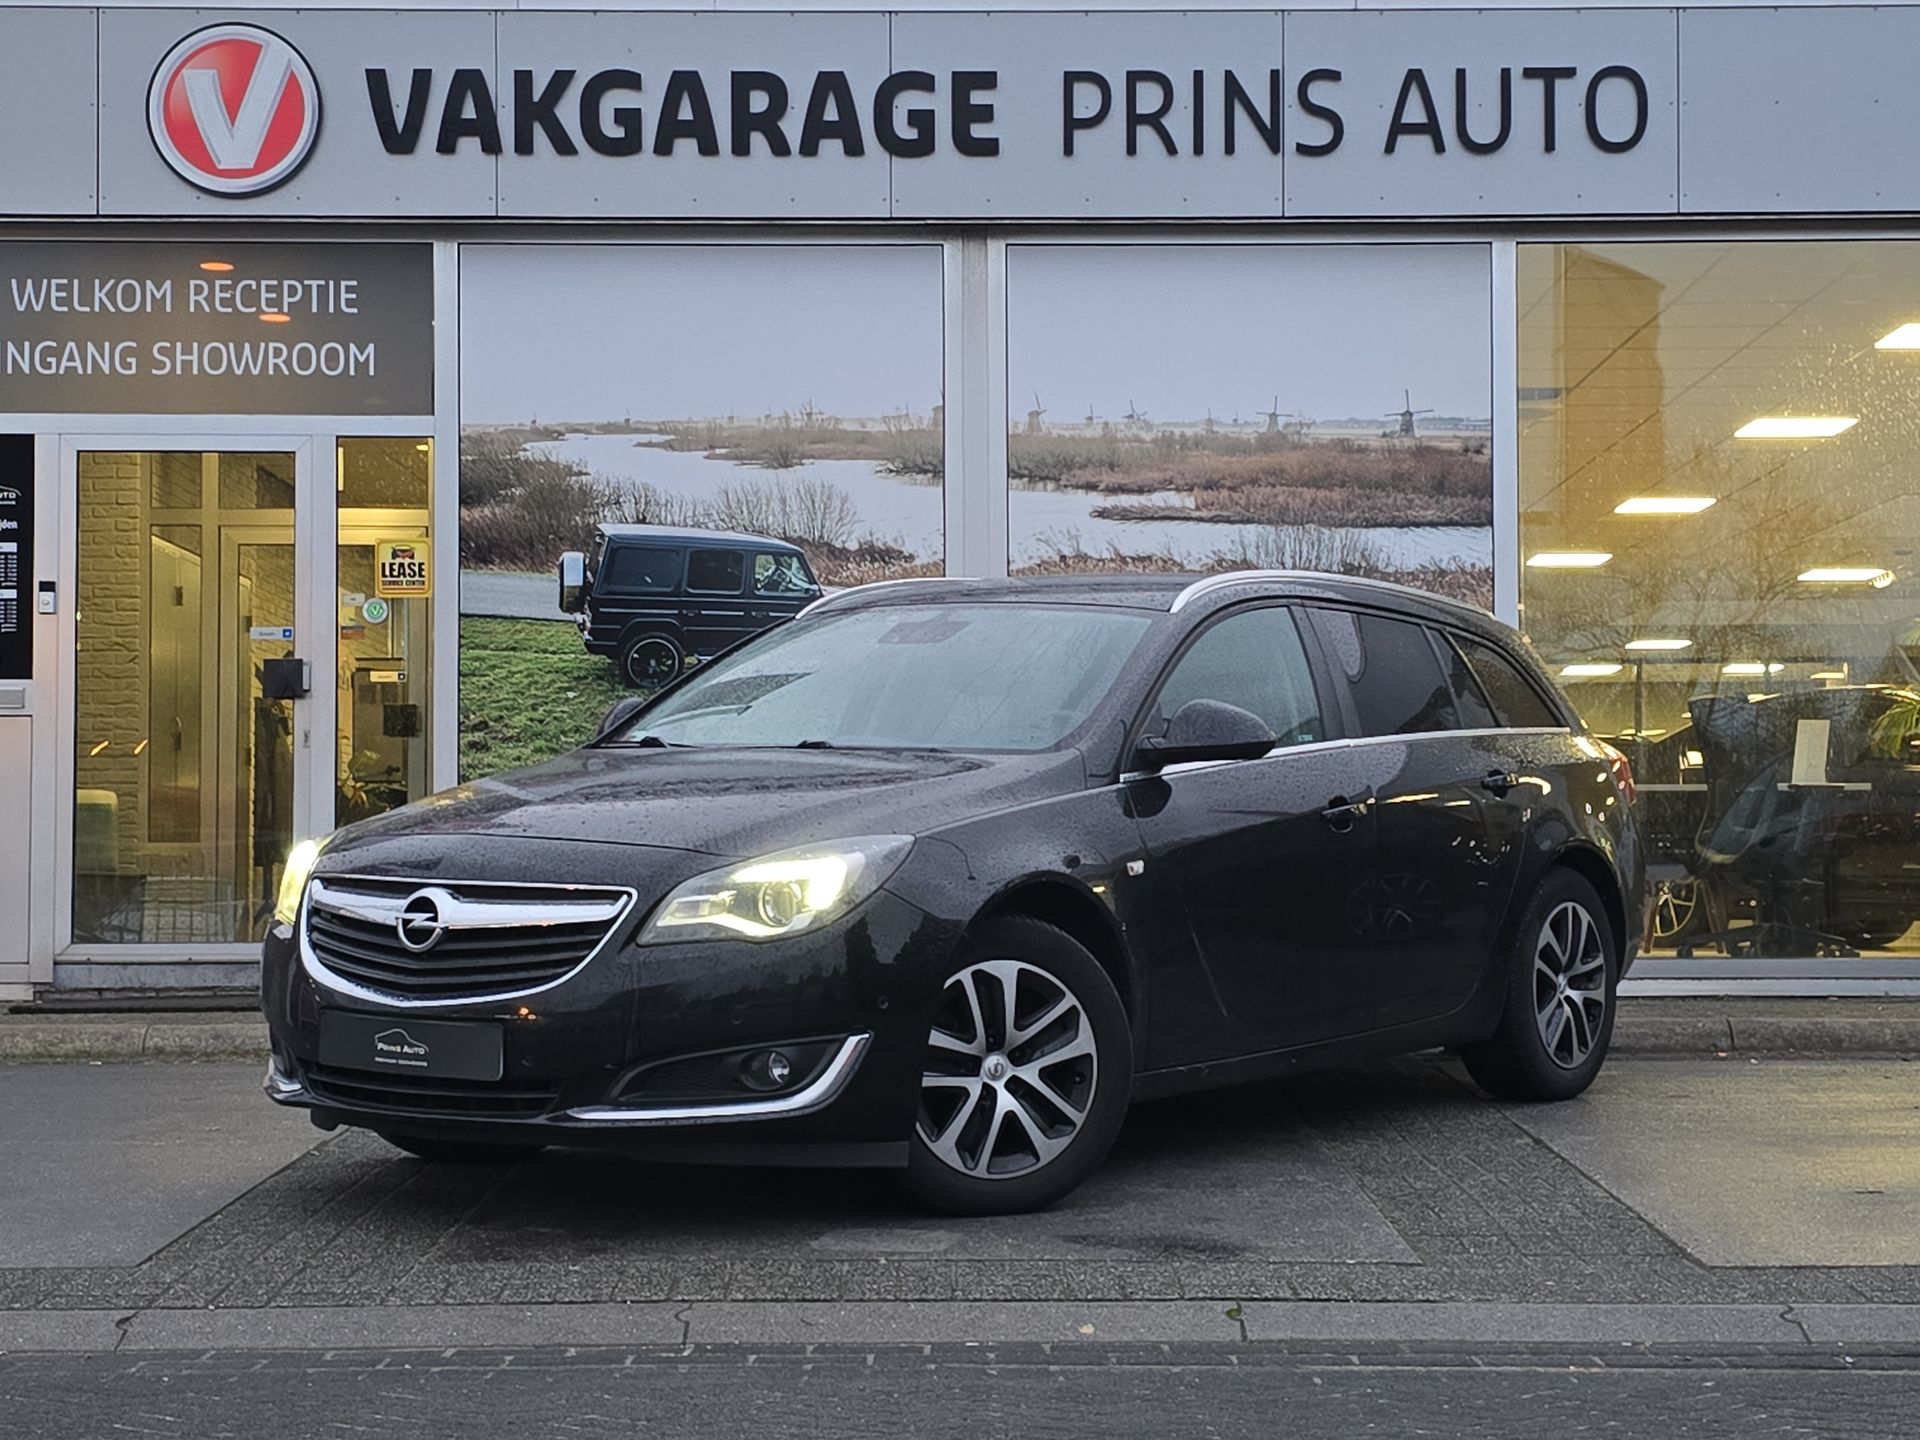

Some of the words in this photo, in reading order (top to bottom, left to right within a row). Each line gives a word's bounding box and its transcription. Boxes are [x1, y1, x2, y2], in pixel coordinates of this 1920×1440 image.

[365, 69, 999, 157] VAKGARAGE
[1063, 68, 1345, 157] PRINS
[1384, 66, 1649, 156] AUTO
[11, 278, 172, 313] WELKOM
[189, 278, 359, 314] RECEPTIE
[0, 340, 137, 376] NGANG
[151, 340, 376, 377] SHOWROOM
[381, 562, 426, 578] LEASE
